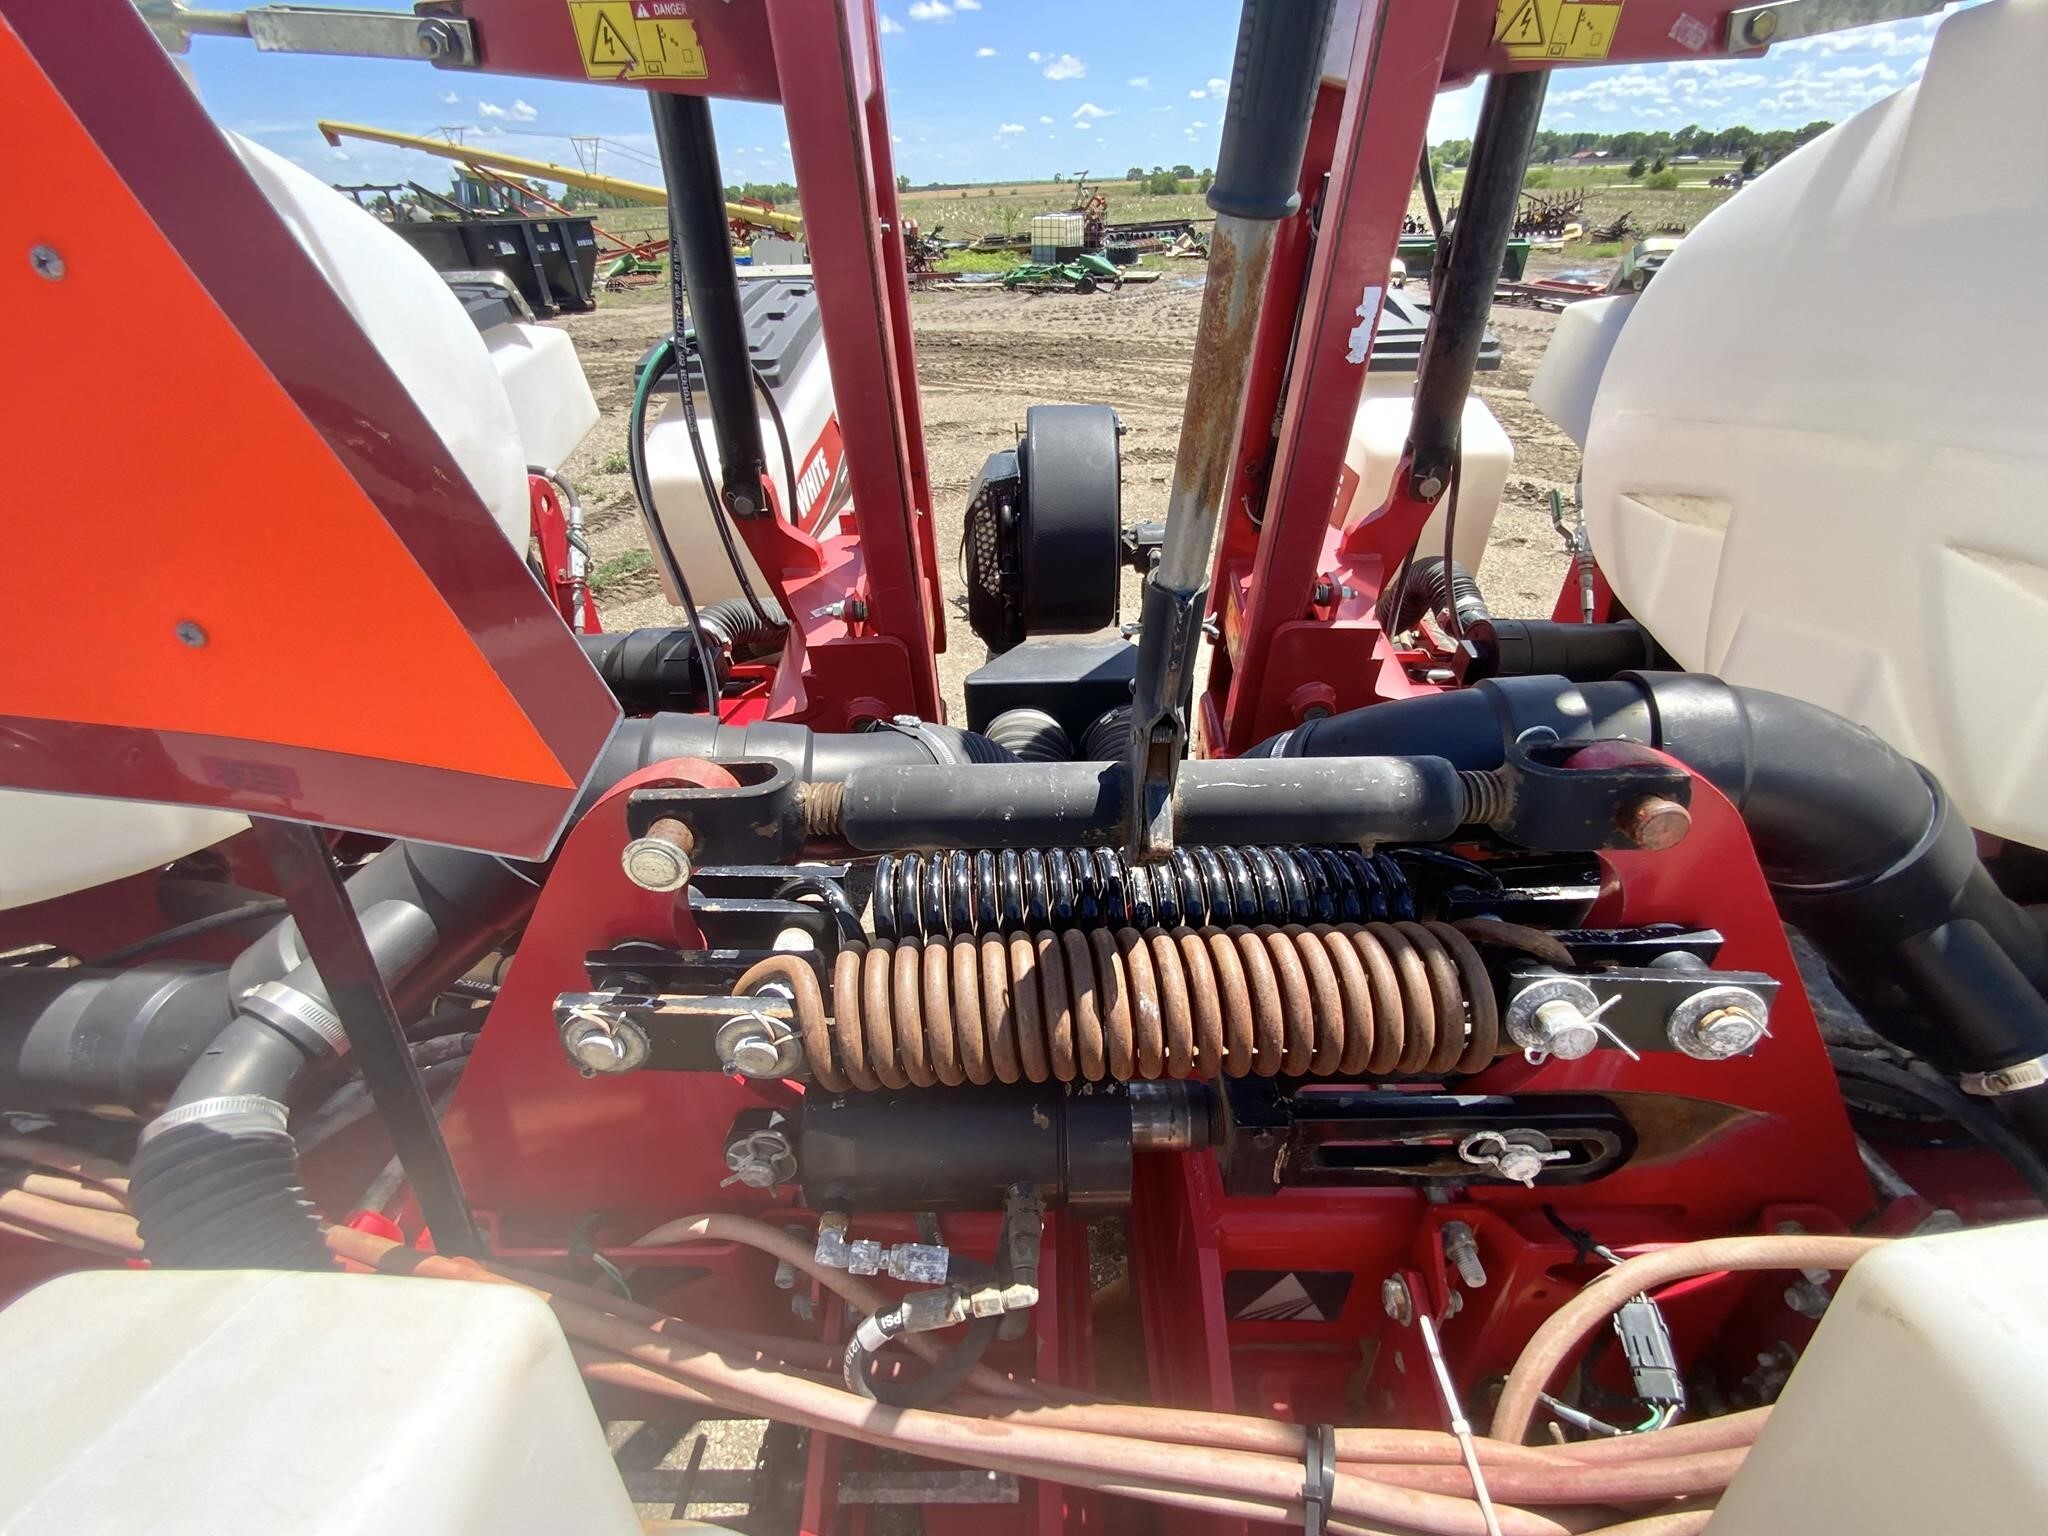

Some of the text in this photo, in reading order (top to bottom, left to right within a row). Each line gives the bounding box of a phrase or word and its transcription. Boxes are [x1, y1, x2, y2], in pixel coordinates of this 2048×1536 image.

[653, 3, 687, 16] DANGER
[674, 284, 682, 298] WP
[675, 300, 684, 334] 471TC-4
[680, 370, 692, 403] TOUGH
[796, 447, 830, 519] WHITE
[880, 1311, 901, 1329] PSI
